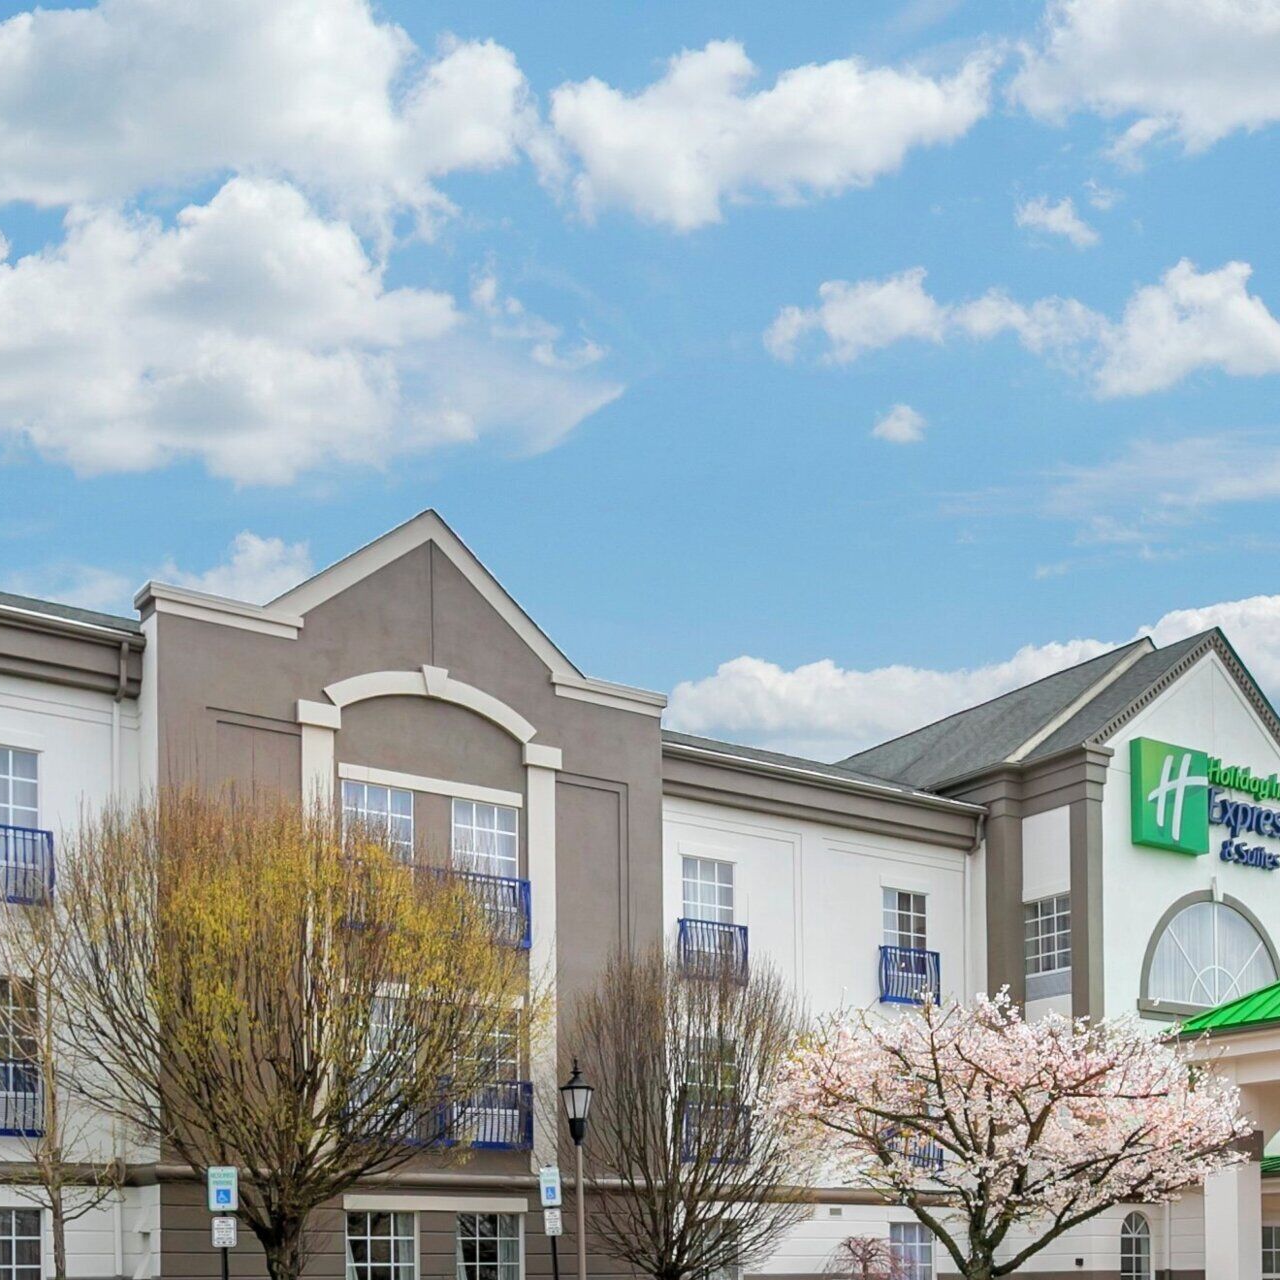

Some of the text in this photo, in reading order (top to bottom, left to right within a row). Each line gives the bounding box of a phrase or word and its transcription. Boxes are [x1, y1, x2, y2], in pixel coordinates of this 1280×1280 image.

[1207, 757, 1270, 801] Holiday
[1220, 840, 1280, 870] & Suites
